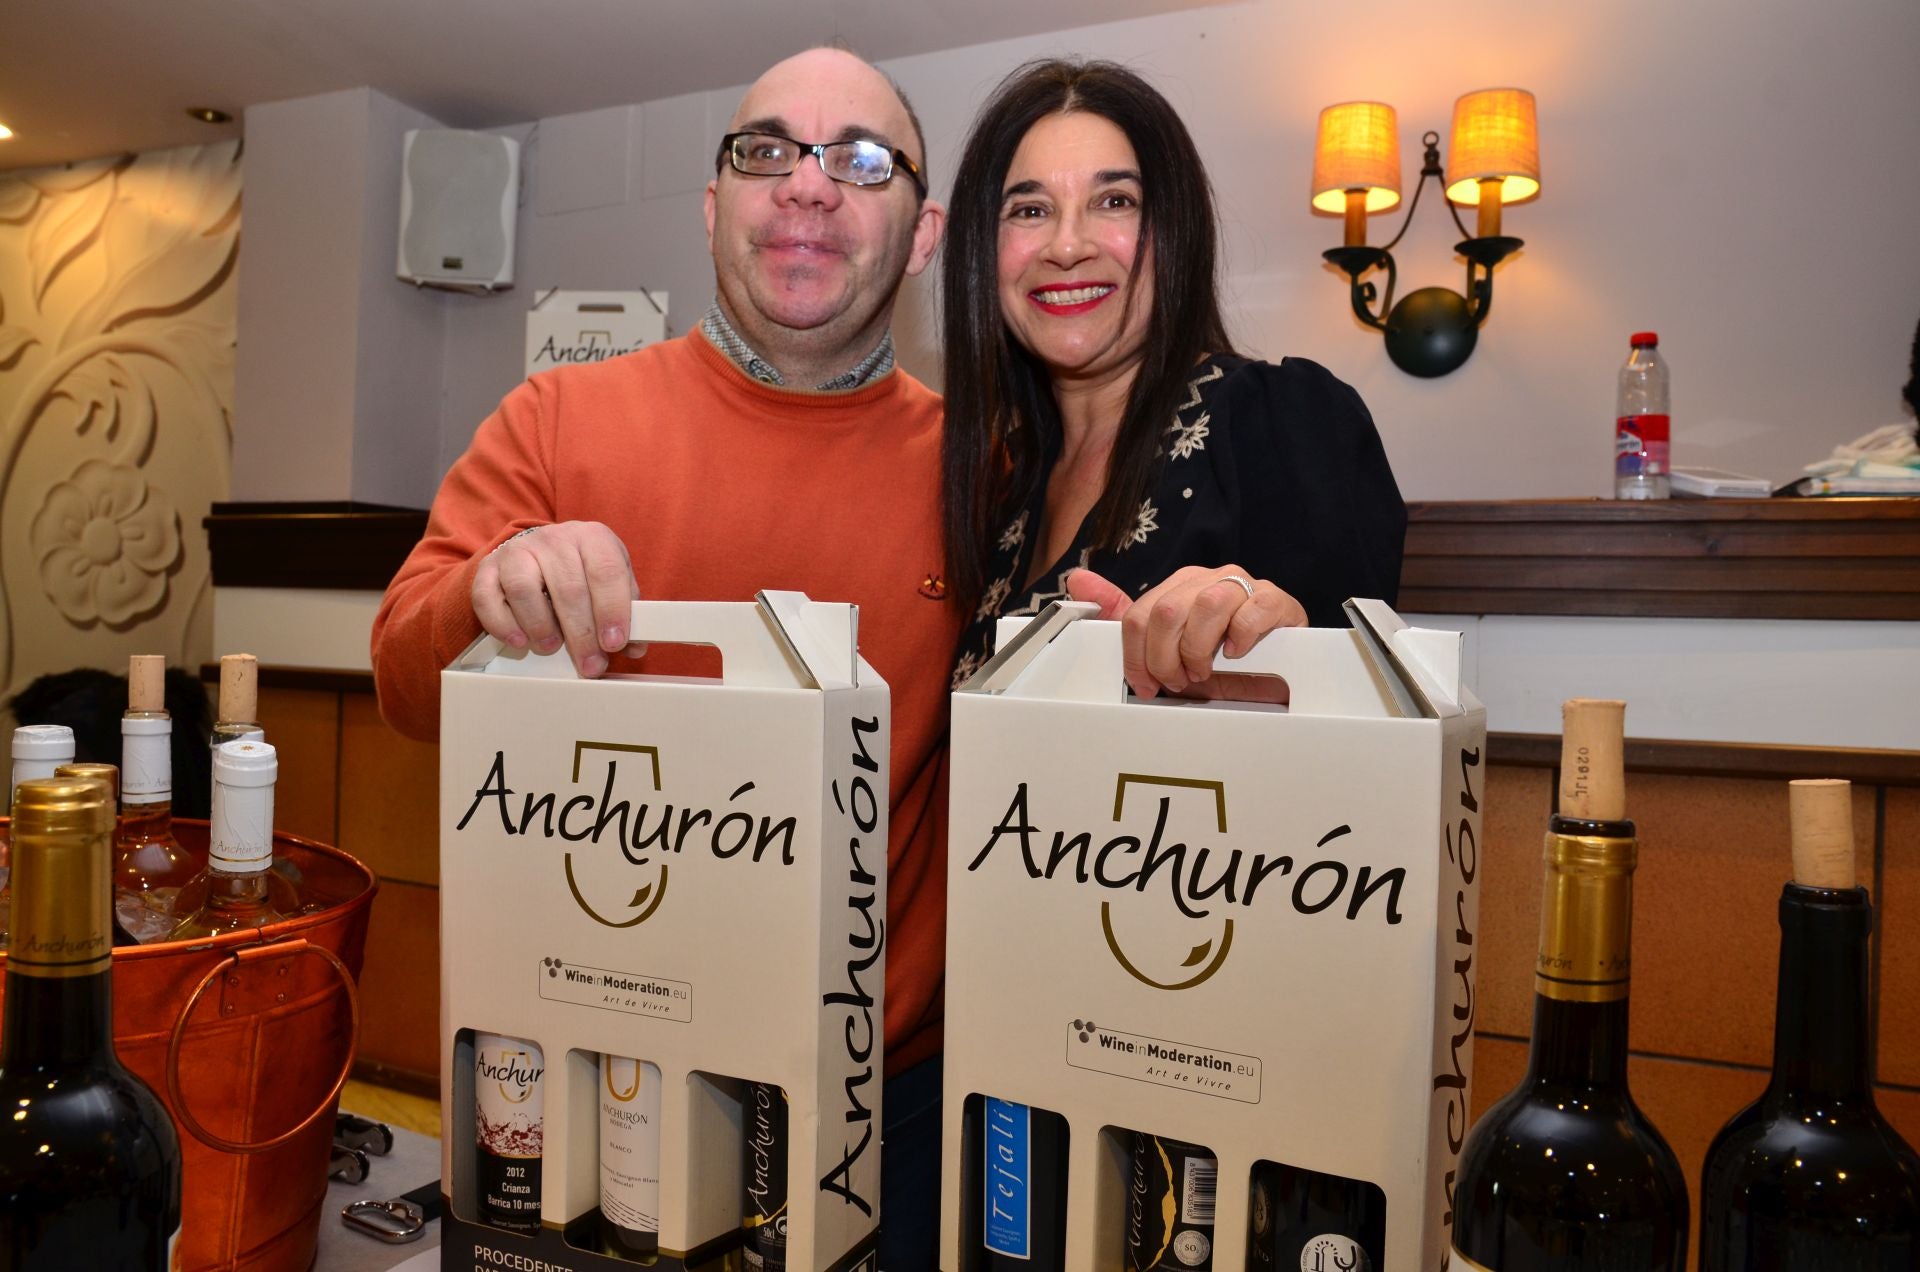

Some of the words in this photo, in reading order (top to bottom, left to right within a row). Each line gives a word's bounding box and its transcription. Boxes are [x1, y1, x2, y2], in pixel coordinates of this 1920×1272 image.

[457, 751, 797, 866] Anchurón
[968, 783, 1406, 925] Anchurón
[820, 716, 884, 1218] Anchurón
[603, 995, 620, 1005] Art
[625, 999, 637, 1007] de
[642, 1002, 670, 1013] Vivre
[1434, 747, 1480, 1272] nchurón
[1147, 1066, 1167, 1078] Art
[1174, 1073, 1189, 1082] de
[1197, 1076, 1232, 1091] Vivre
[506, 1166, 525, 1178] 2012
[502, 1182, 531, 1194] Crianza
[487, 1193, 511, 1209] Barrica
[513, 1199, 522, 1210] 10
